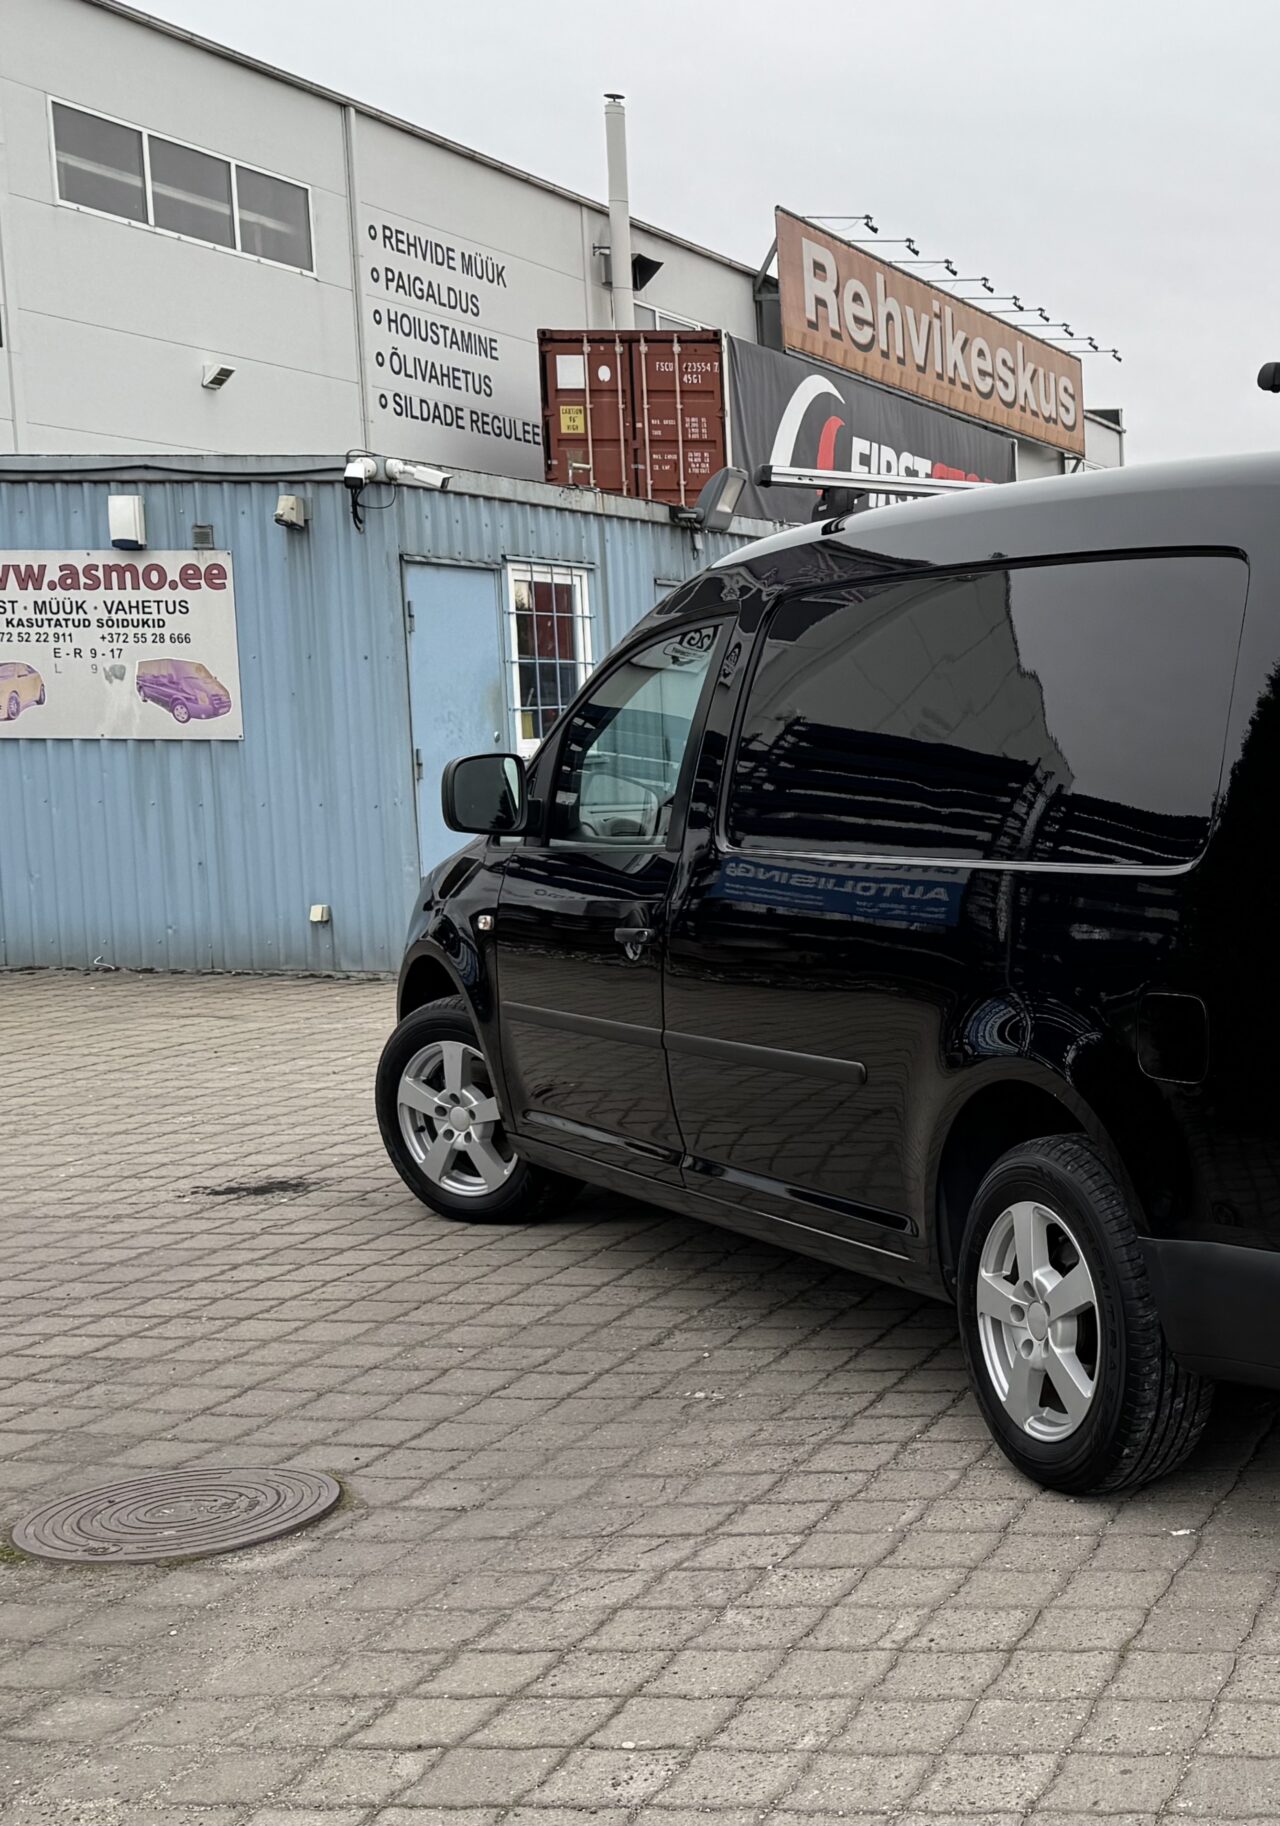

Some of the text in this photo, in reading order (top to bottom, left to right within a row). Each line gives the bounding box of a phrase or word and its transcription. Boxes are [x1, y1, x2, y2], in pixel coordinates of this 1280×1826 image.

[381, 224, 508, 288] REHVIDE MÜÜK
[384, 267, 480, 317] PAIGALDUS
[387, 309, 499, 361] HOIUSTAMINE
[801, 237, 1078, 432] Rehvikeskus
[389, 346, 493, 398] ÕLIVAHETUS
[392, 392, 465, 430] SILDADE
[5, 616, 167, 629] KASUTATUD SÕIDUKID
[33, 597, 88, 615] MÜÜK
[103, 600, 190, 615] VAHETUS
[17, 632, 31, 643] 52
[35, 632, 49, 643] 22
[53, 632, 73, 643] 911
[99, 632, 192, 644] +372 55 28 666
